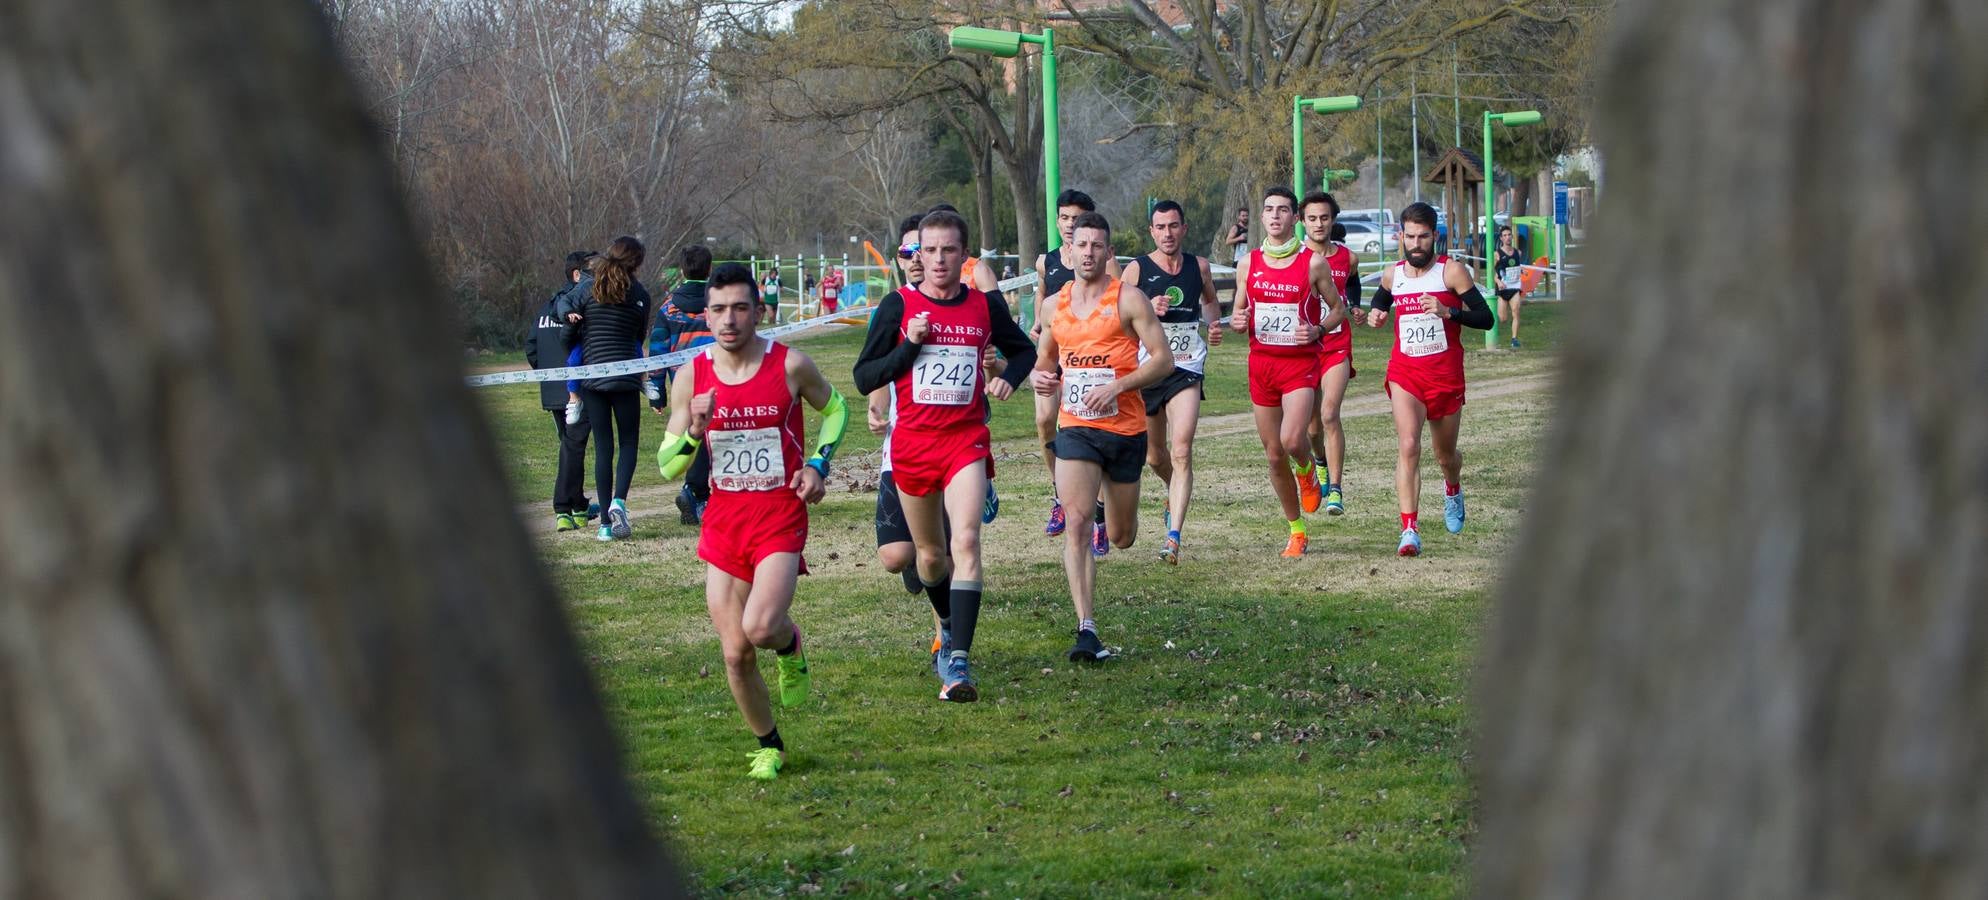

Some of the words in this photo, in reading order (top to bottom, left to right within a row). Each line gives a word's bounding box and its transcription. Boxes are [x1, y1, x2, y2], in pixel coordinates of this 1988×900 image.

[1253, 280, 1300, 292] AÑARES
[931, 323, 983, 336] ÑARES
[1261, 315, 1292, 333] 242
[937, 336, 965, 344] RIOJA
[1406, 325, 1437, 344] 204
[1066, 352, 1110, 367] ferrer
[918, 363, 973, 386] 1242
[713, 405, 779, 418] ÑARES
[723, 420, 757, 429] RIOJA
[722, 448, 769, 474] 206
